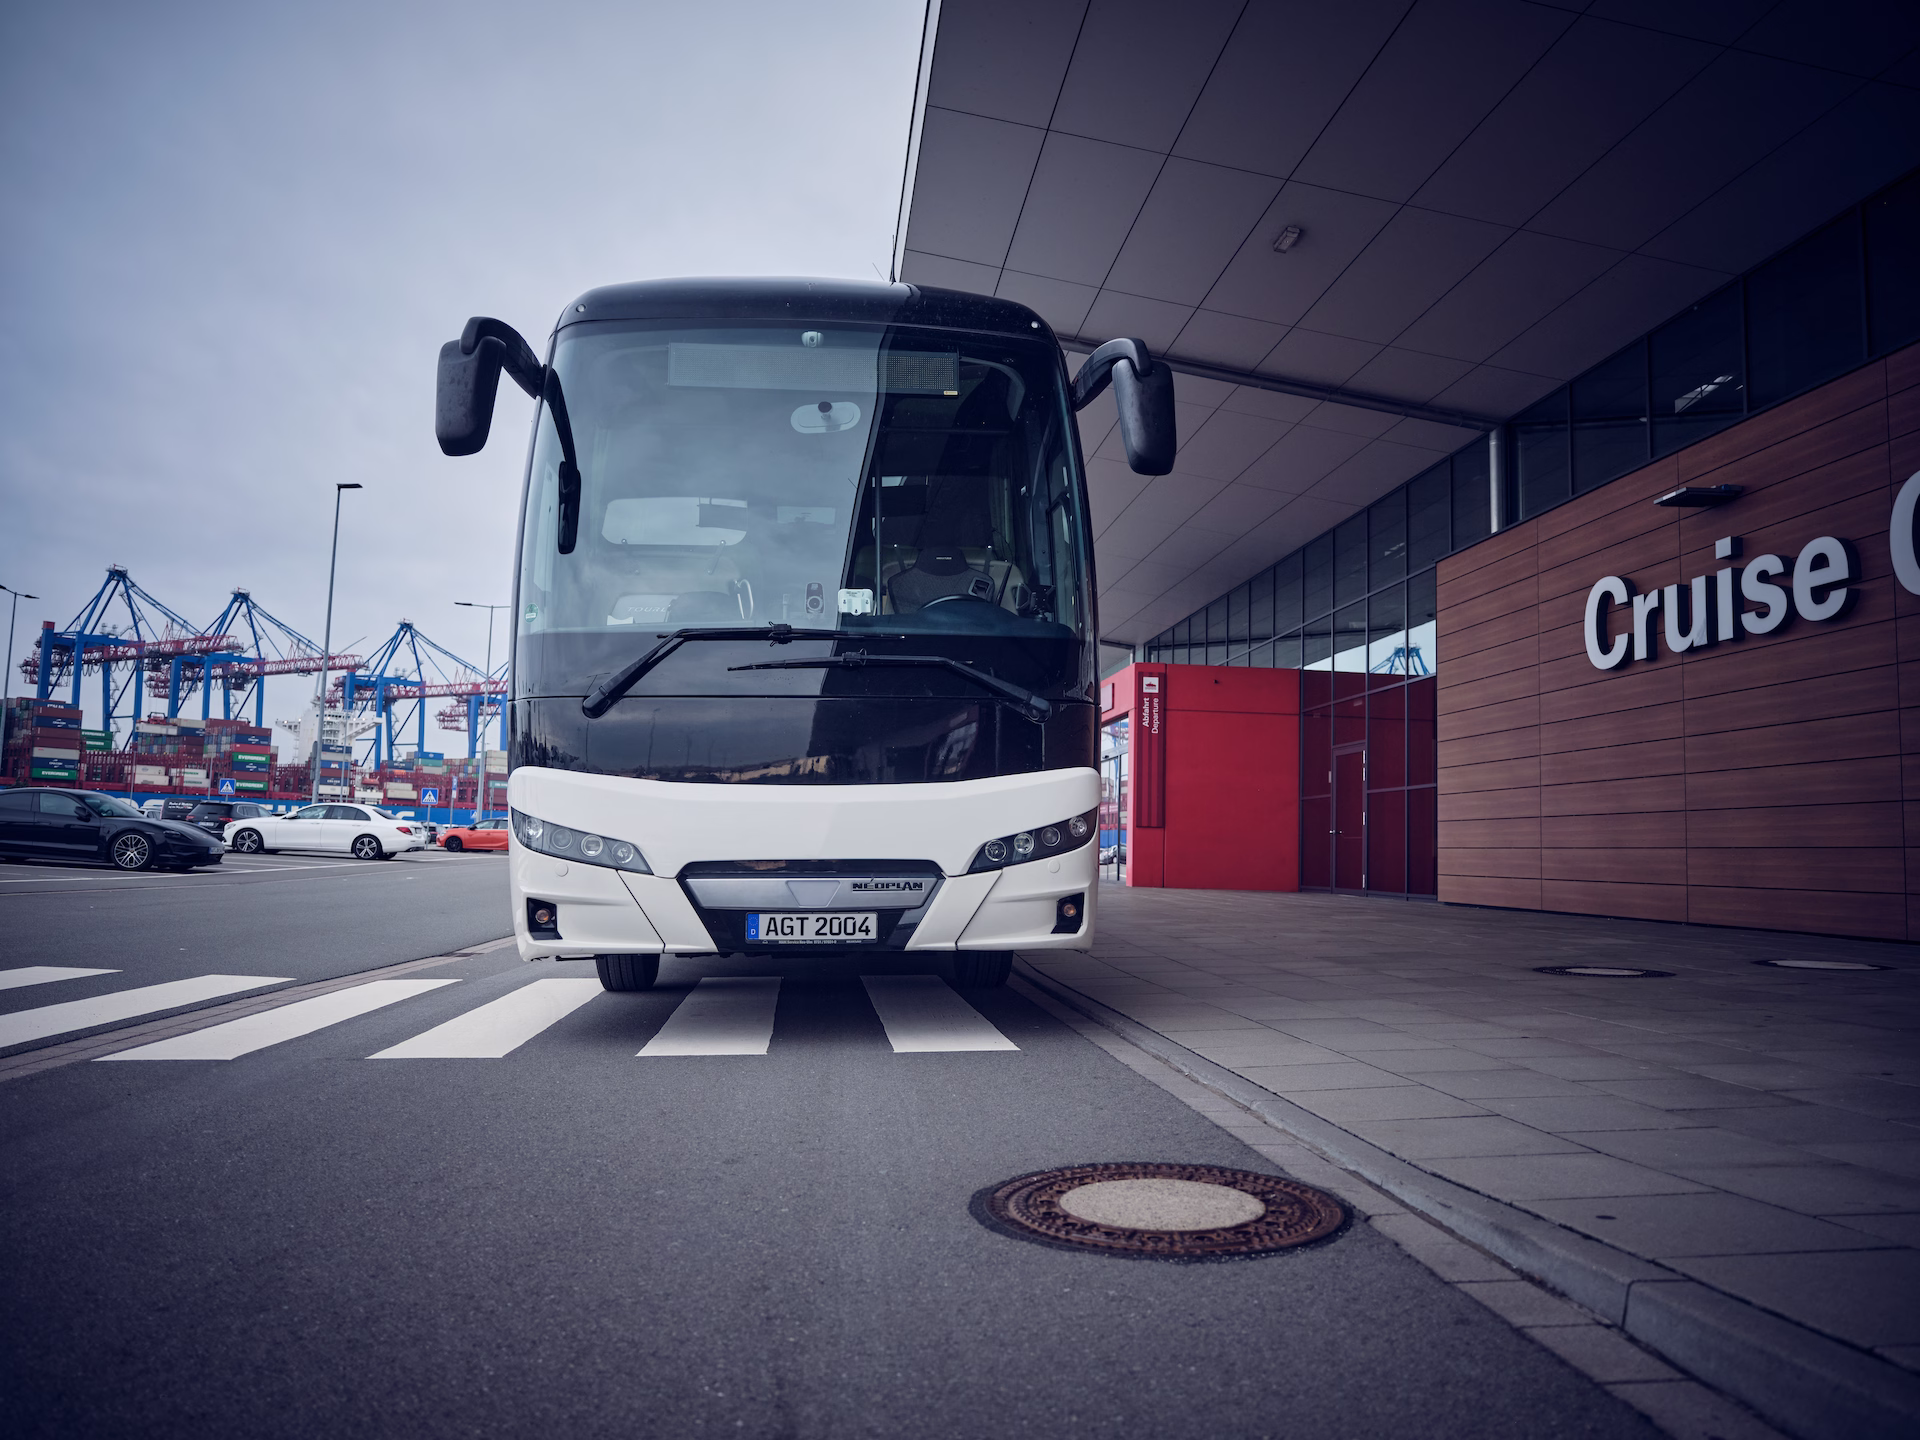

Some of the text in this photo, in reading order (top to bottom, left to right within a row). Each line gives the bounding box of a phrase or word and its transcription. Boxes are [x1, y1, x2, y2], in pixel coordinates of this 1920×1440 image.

[1584, 536, 1854, 671] Cruise
[1151, 698, 1159, 734] Departure
[765, 916, 871, 936] AGT 2004
